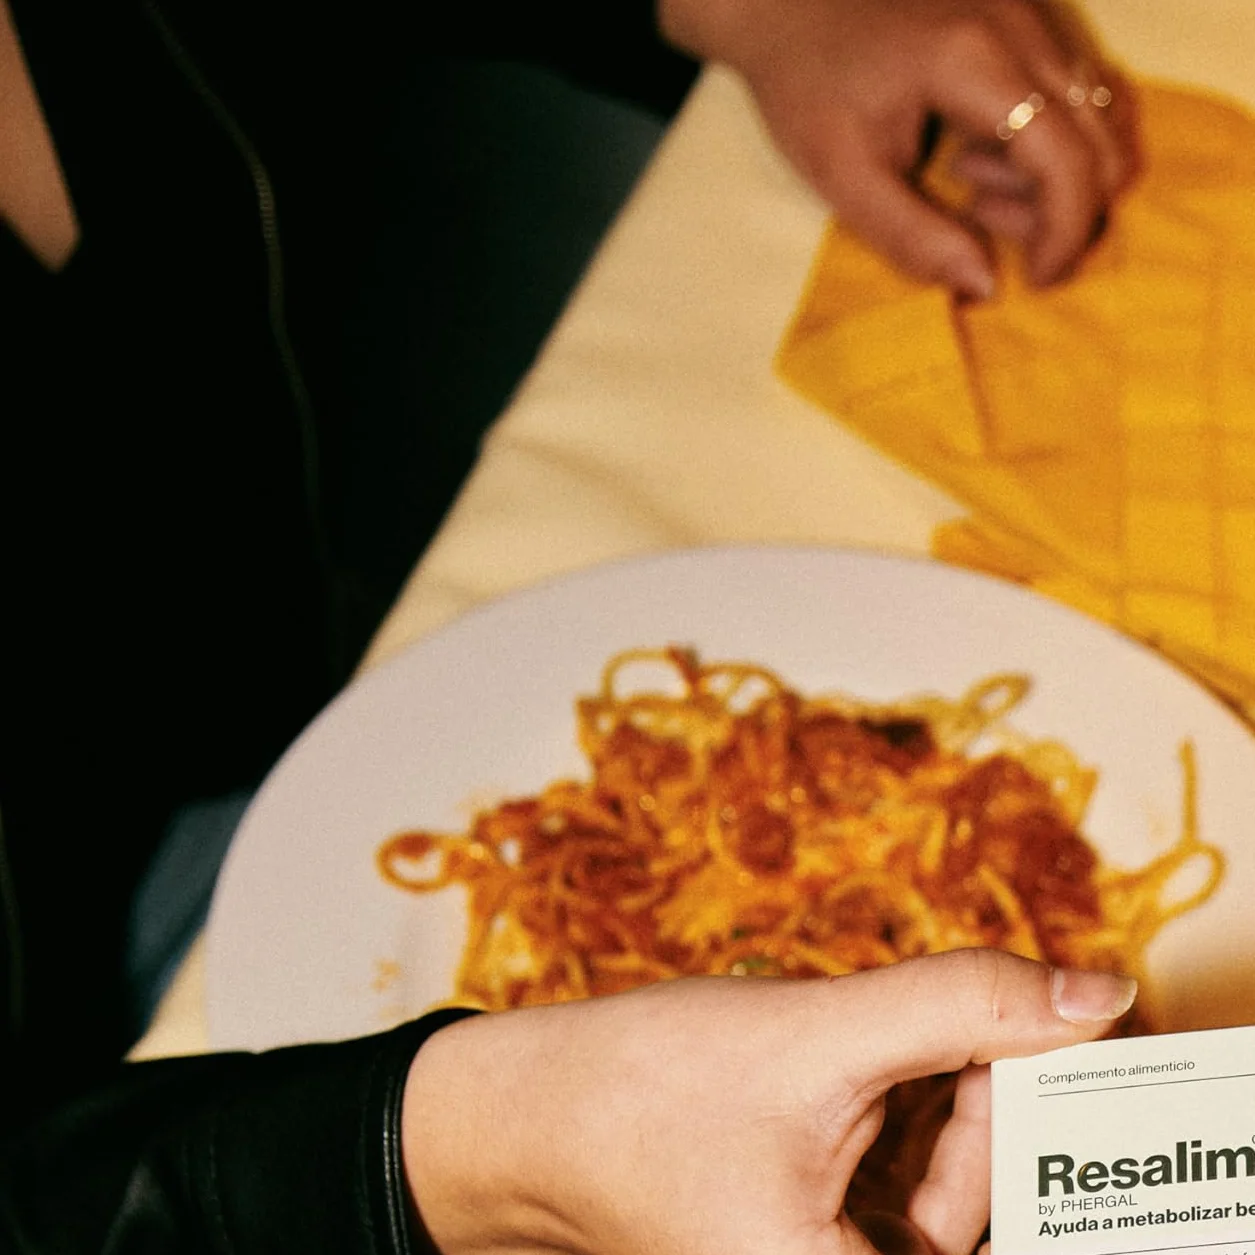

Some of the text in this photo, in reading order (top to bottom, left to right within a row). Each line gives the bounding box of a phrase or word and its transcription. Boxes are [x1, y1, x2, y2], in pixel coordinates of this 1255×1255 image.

[1038, 1060, 1196, 1085] Complemento alimenticio
[1038, 1193, 1138, 1217] by PHERGAL
[1038, 1216, 1099, 1239] Ayuda
[1101, 1217, 1114, 1230] a
[1116, 1205, 1233, 1229] metabolizar
